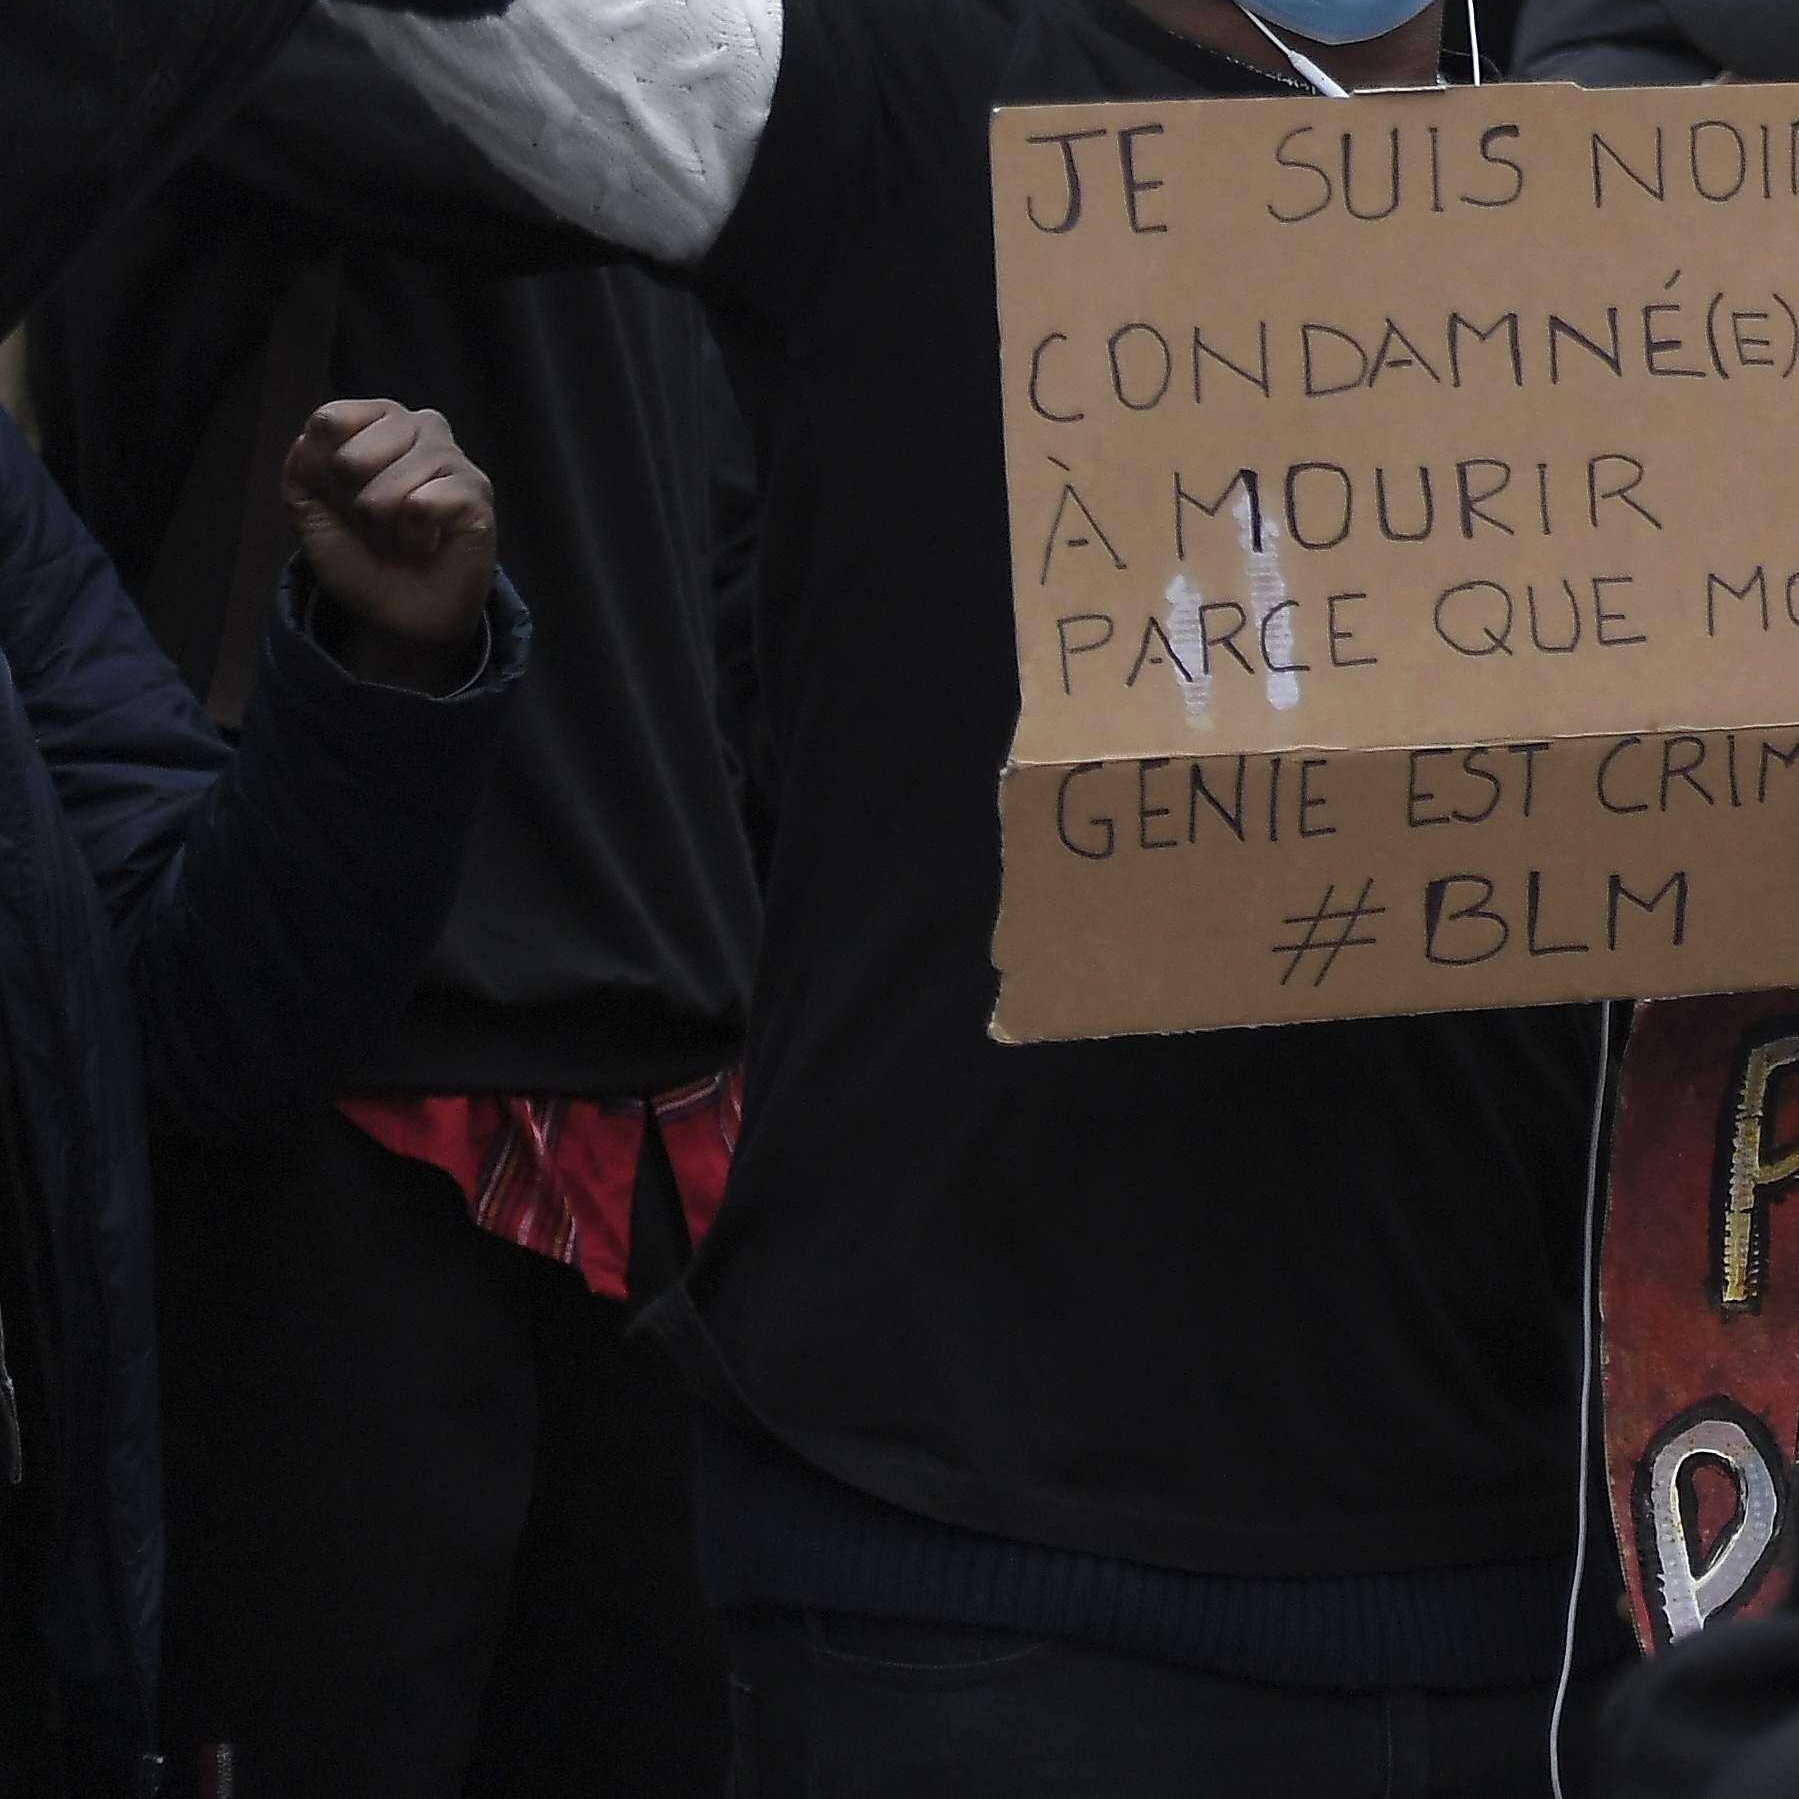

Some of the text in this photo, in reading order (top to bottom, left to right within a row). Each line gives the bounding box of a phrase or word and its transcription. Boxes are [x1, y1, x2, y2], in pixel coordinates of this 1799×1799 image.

[1026, 123, 1171, 236] JE
[1267, 122, 1526, 225] SUIS
[1038, 453, 1664, 587] À MOURIR
[1055, 592, 1378, 697] PARCE
[1431, 576, 1648, 658] QUE
[1406, 741, 1553, 829] EST
[1270, 876, 1690, 988] #BLM
